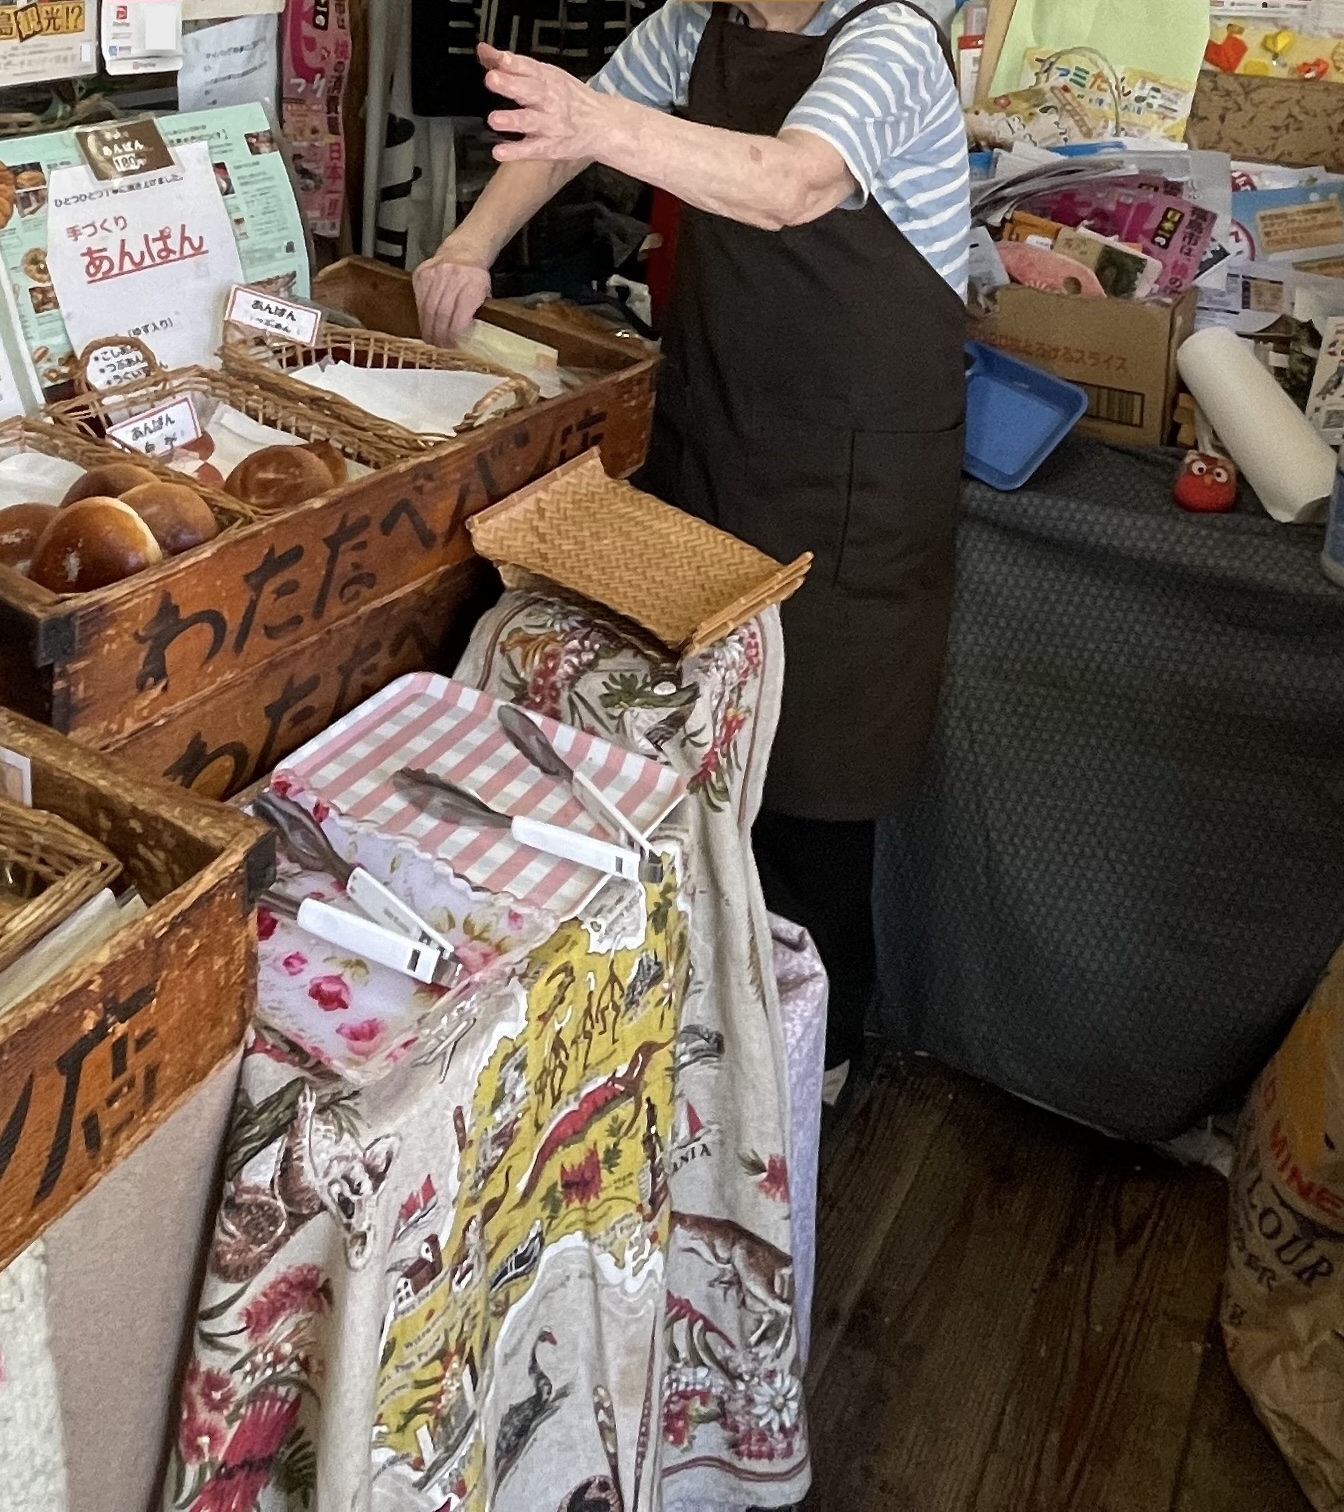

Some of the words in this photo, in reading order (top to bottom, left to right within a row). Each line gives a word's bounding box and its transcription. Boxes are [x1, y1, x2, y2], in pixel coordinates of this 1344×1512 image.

[66, 215, 128, 242] 手づくり
[80, 223, 205, 280] あんぱん
